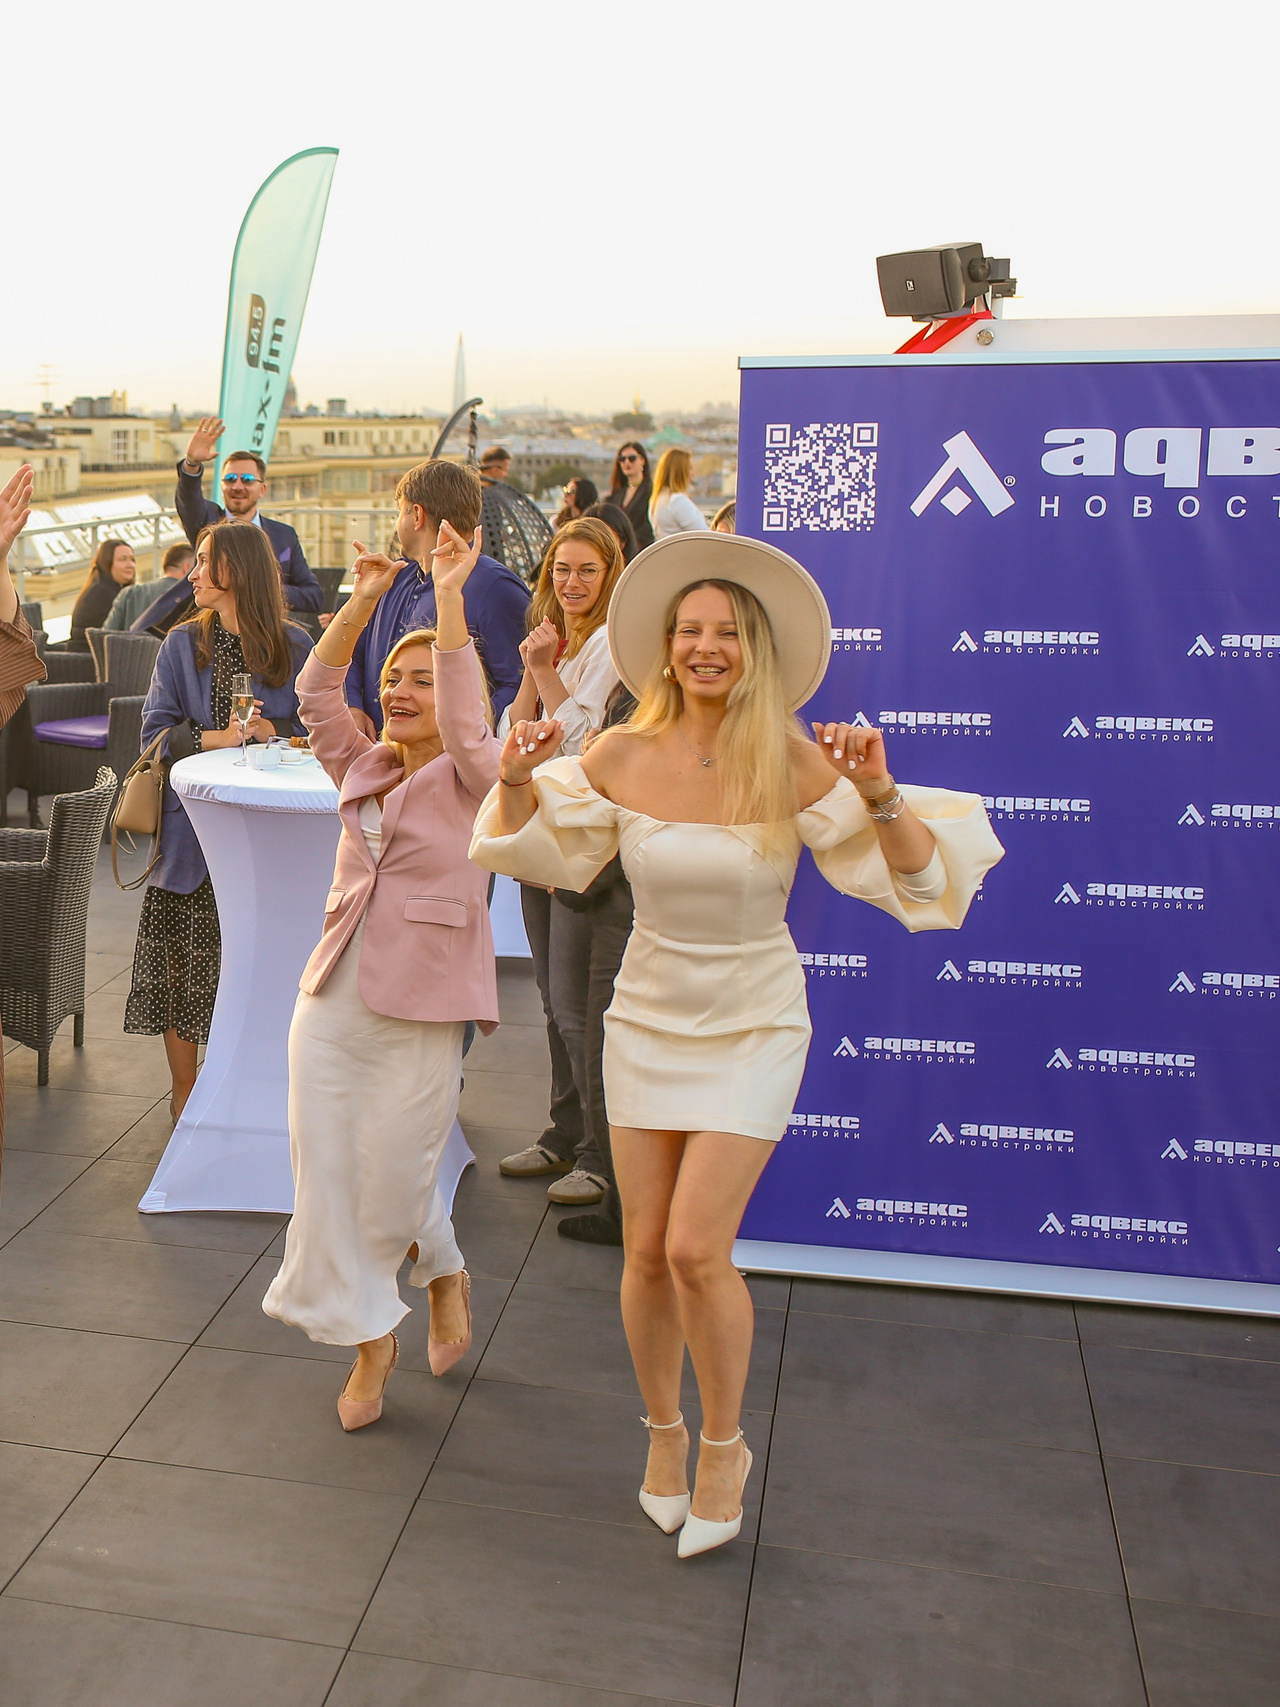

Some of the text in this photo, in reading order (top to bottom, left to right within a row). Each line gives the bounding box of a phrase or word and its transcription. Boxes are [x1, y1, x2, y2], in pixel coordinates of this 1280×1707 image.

[248, 305, 264, 356] 94.5
[987, 813, 1091, 822] овостройки
[809, 968, 867, 978] тройки
